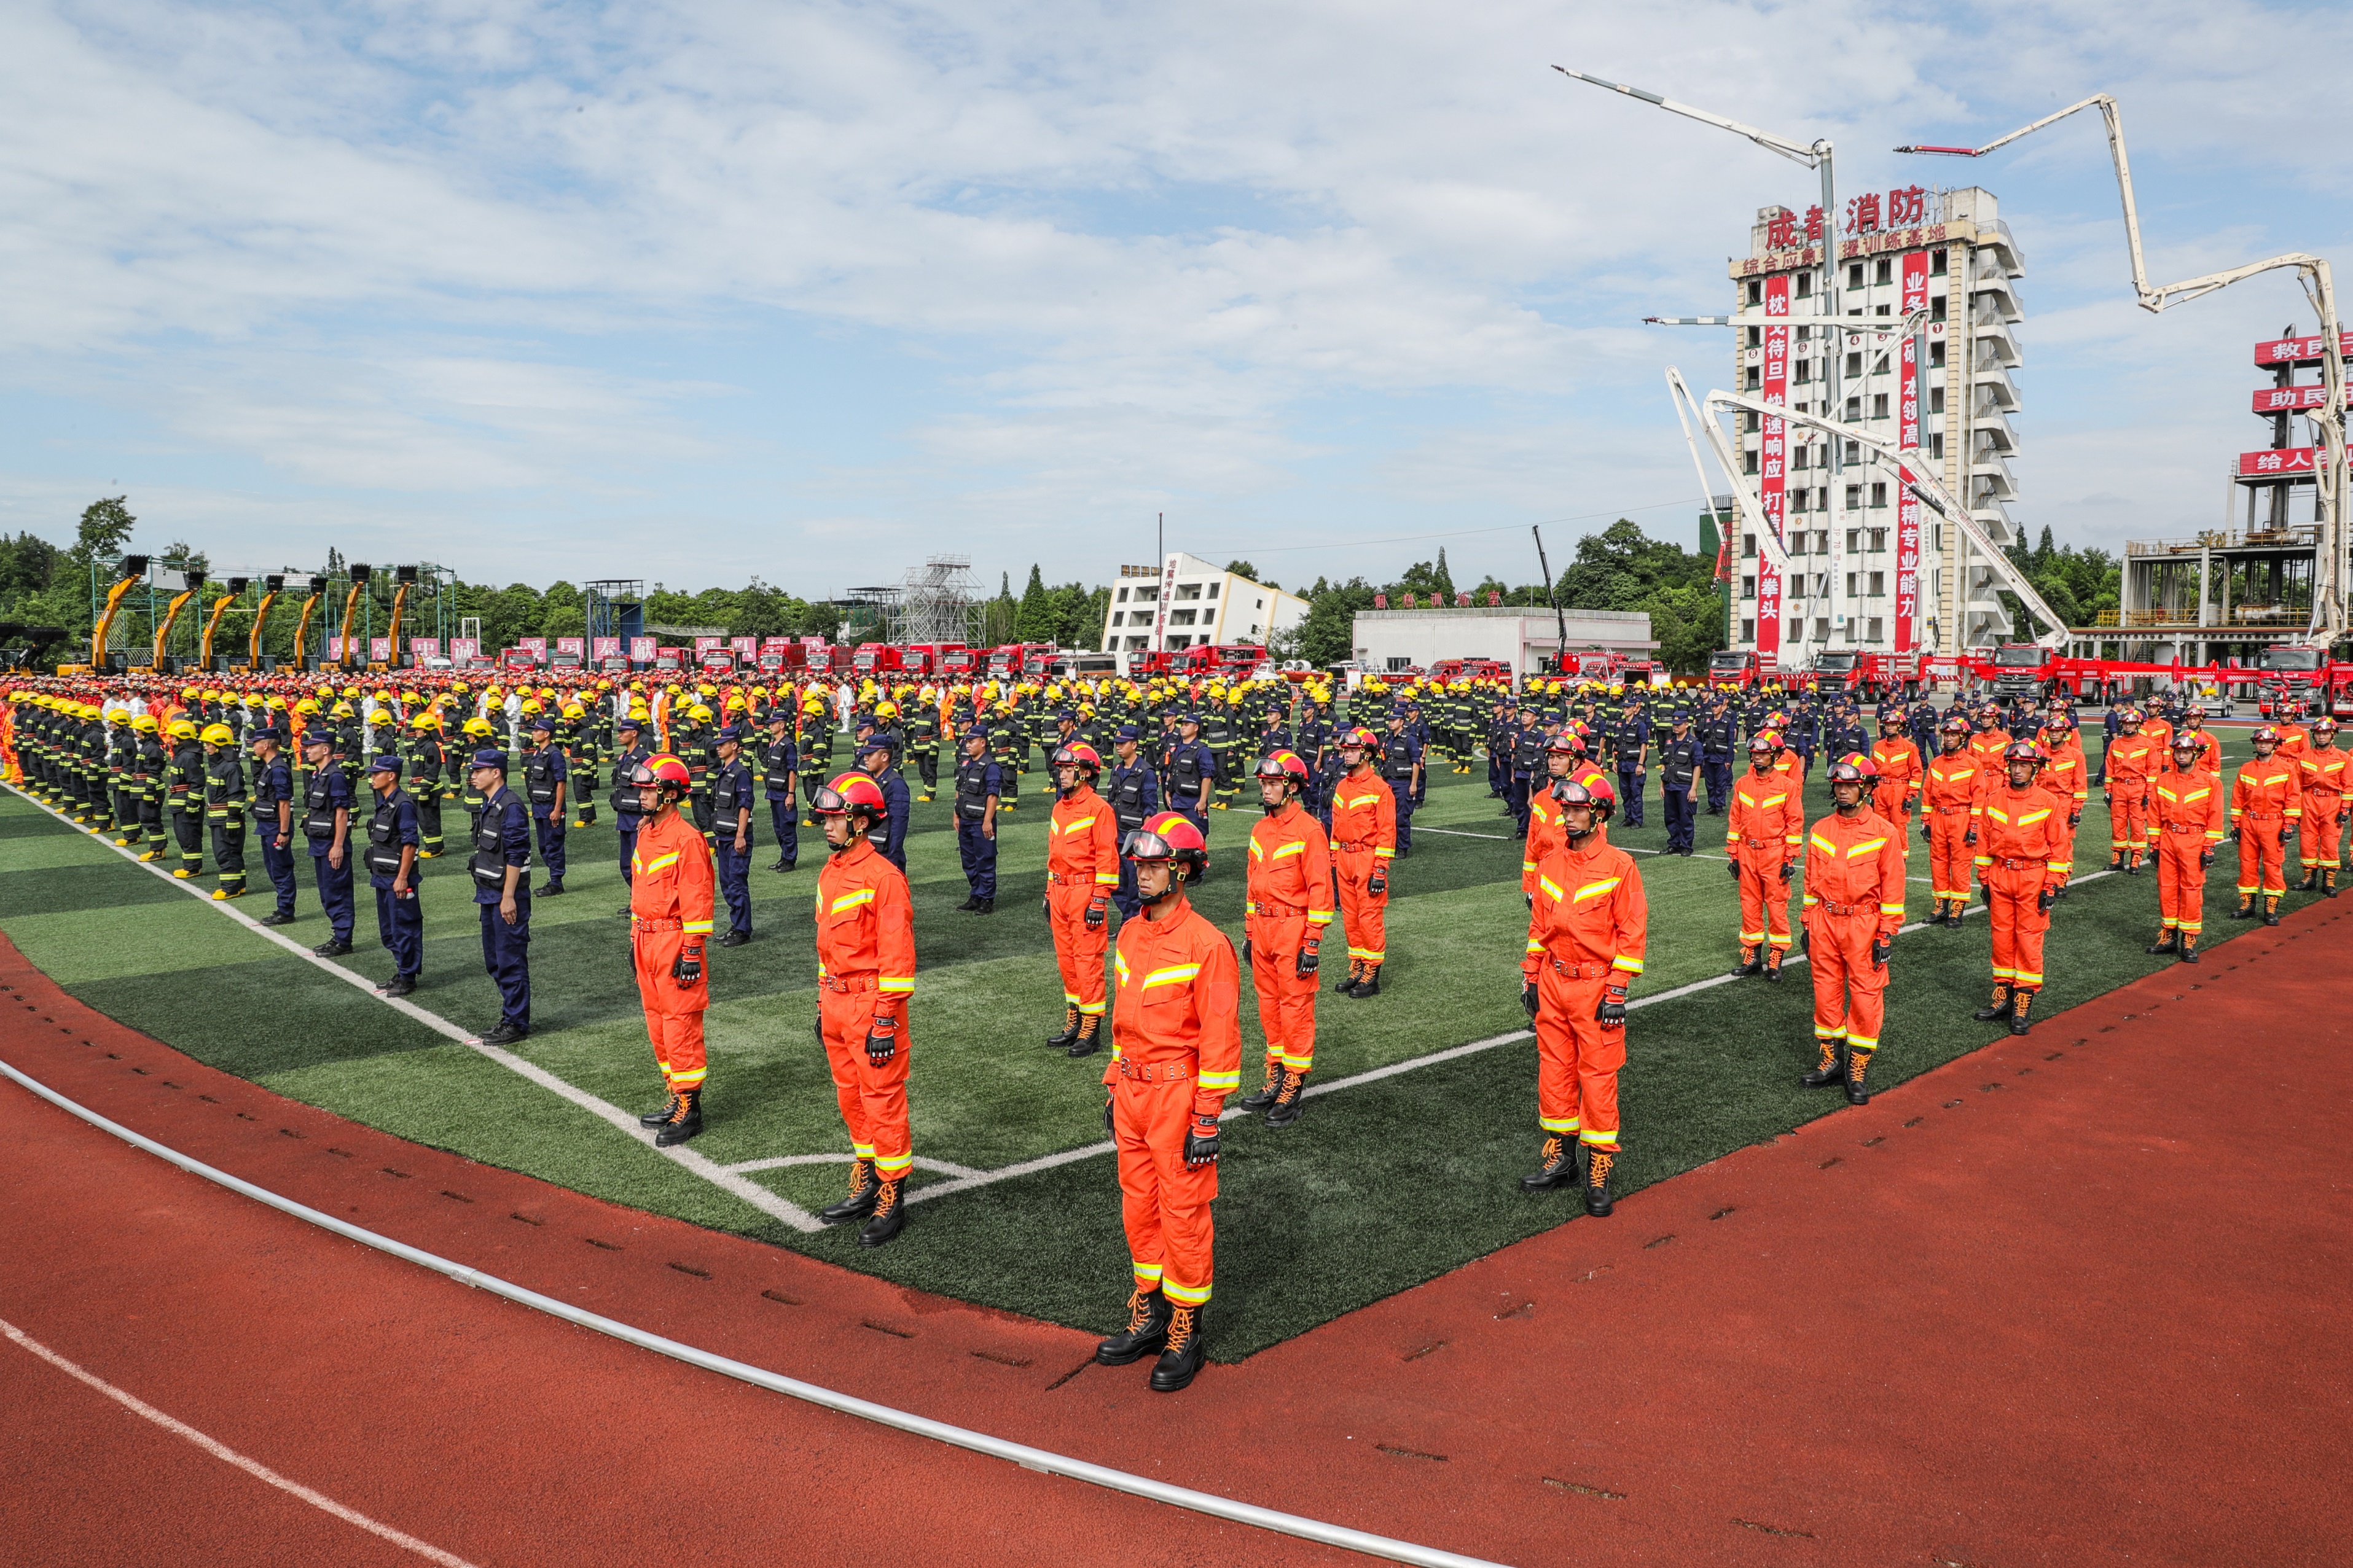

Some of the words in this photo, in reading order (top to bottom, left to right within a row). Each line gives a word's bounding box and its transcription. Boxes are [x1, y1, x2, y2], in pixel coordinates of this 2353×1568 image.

[1742, 222, 1947, 275] 综合应急援训练基地
